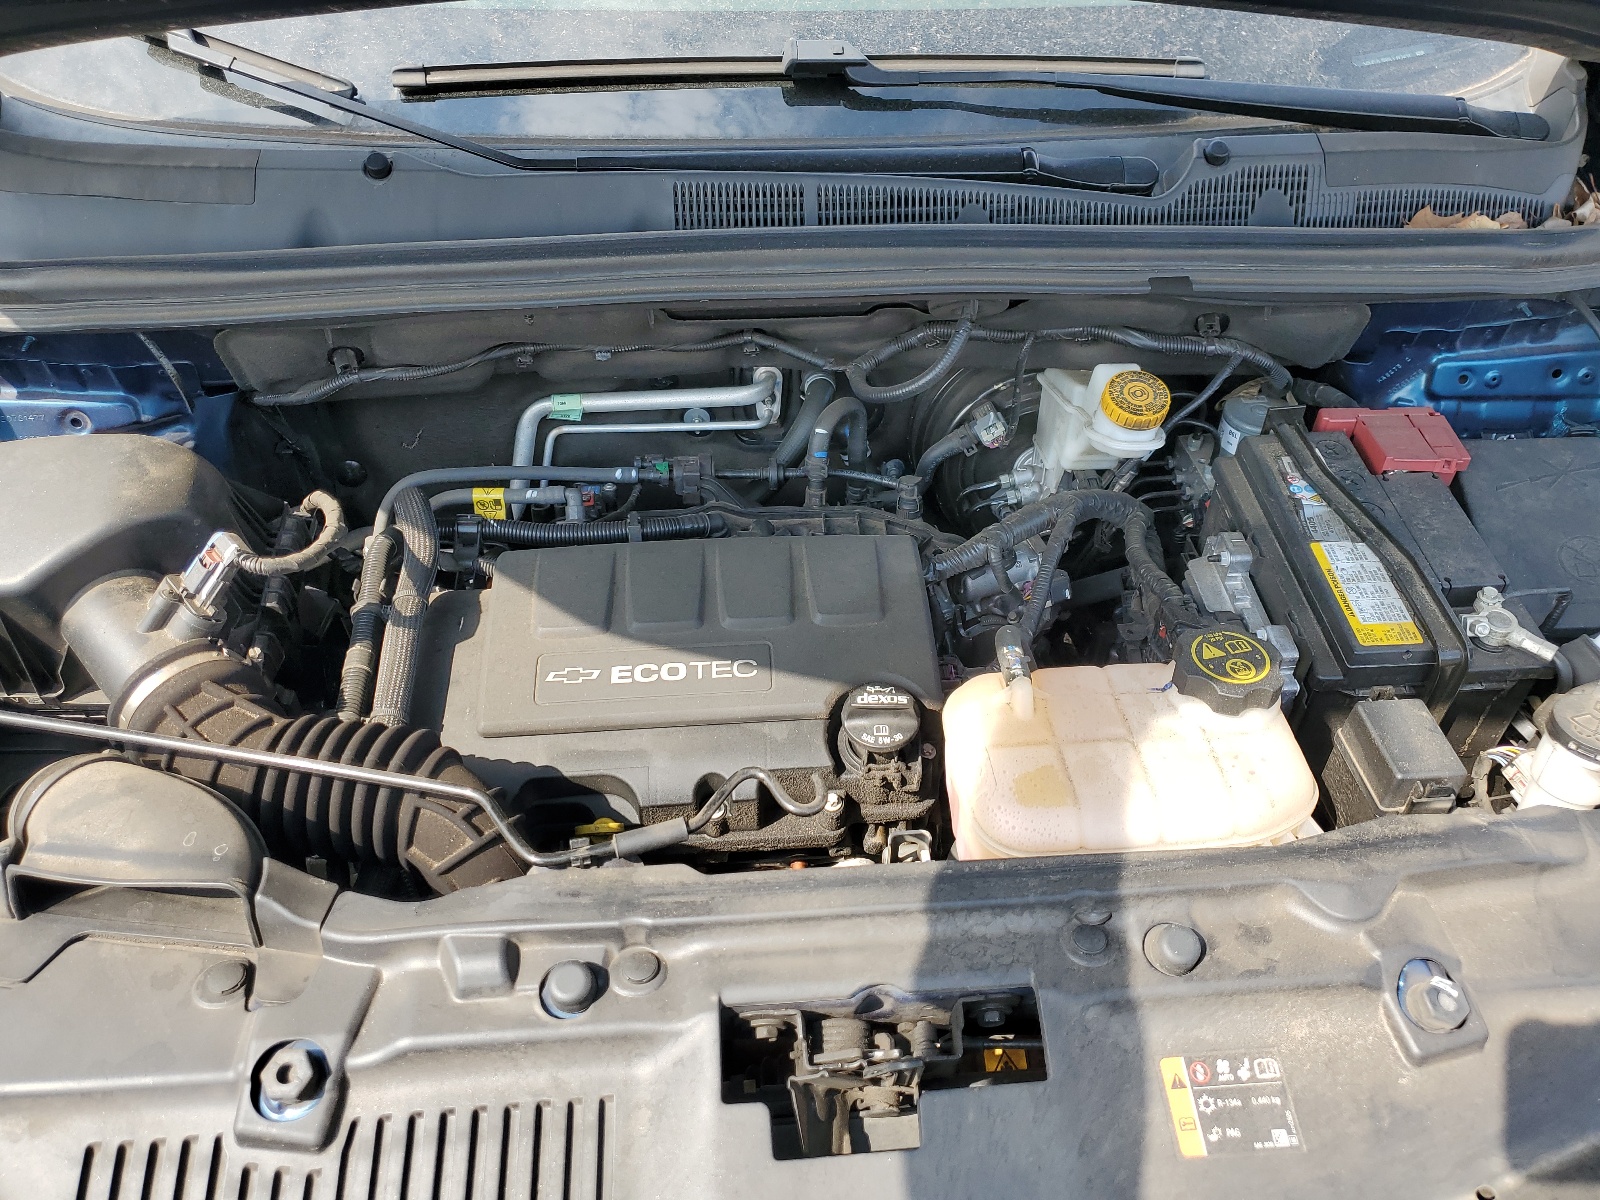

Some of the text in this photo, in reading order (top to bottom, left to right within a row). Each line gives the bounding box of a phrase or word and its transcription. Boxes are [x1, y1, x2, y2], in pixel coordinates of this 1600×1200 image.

[1326, 568, 1352, 612] DANGER POISON
[611, 660, 757, 684] ECOTEC
[857, 693, 909, 704] dexos
